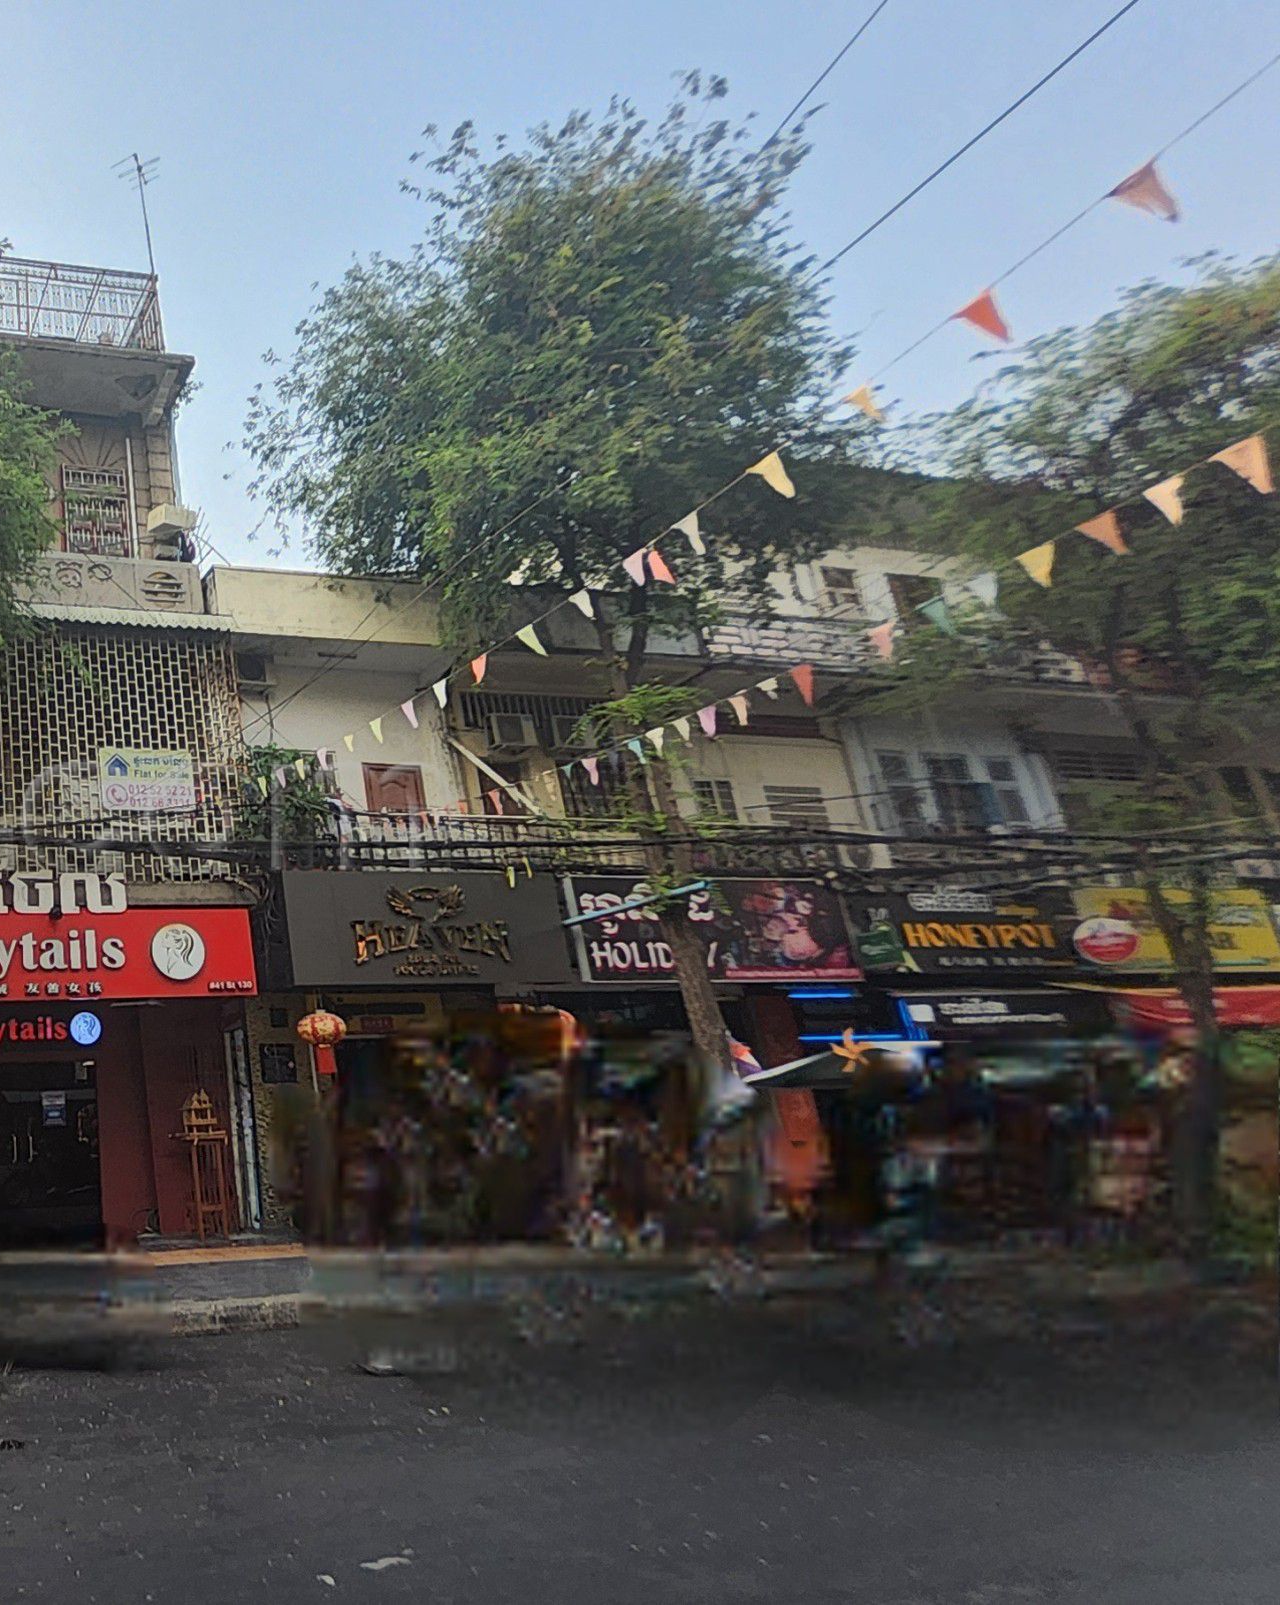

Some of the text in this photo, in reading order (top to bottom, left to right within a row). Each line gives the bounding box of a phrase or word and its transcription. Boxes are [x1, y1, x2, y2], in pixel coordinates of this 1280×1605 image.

[134, 769, 151, 778] Flat
[128, 784, 147, 795] 012
[349, 920, 513, 966] HEAVEN
[901, 922, 1056, 948] HONEYPOT
[590, 941, 718, 969] HOLID
